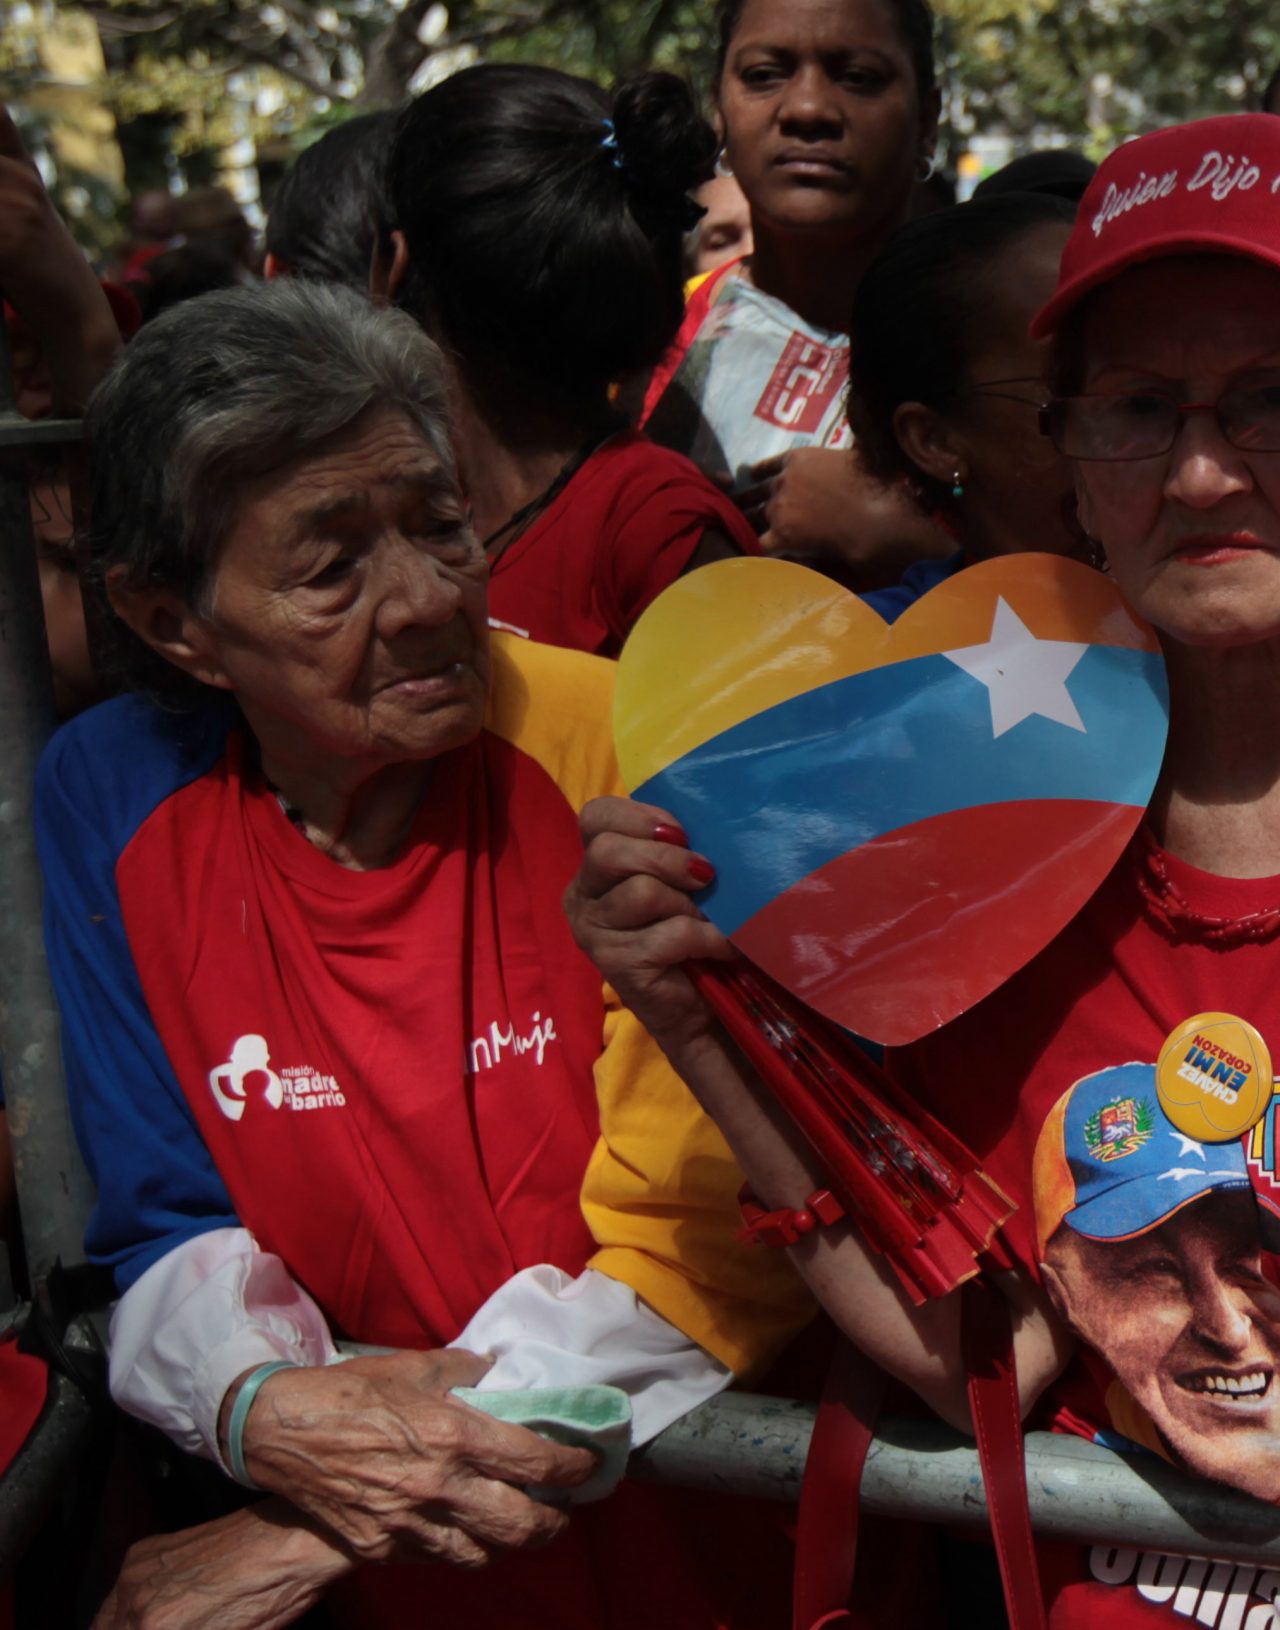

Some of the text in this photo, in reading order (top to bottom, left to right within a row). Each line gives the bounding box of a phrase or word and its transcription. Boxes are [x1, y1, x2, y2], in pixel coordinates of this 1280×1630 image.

[1091, 169, 1178, 238] Quien
[1187, 150, 1260, 201] Dijo
[281, 1065, 315, 1077] misión
[1177, 1062, 1239, 1104] CHÁVEZ
[1184, 1046, 1248, 1092] EN MI
[291, 1090, 346, 1111] barrio
